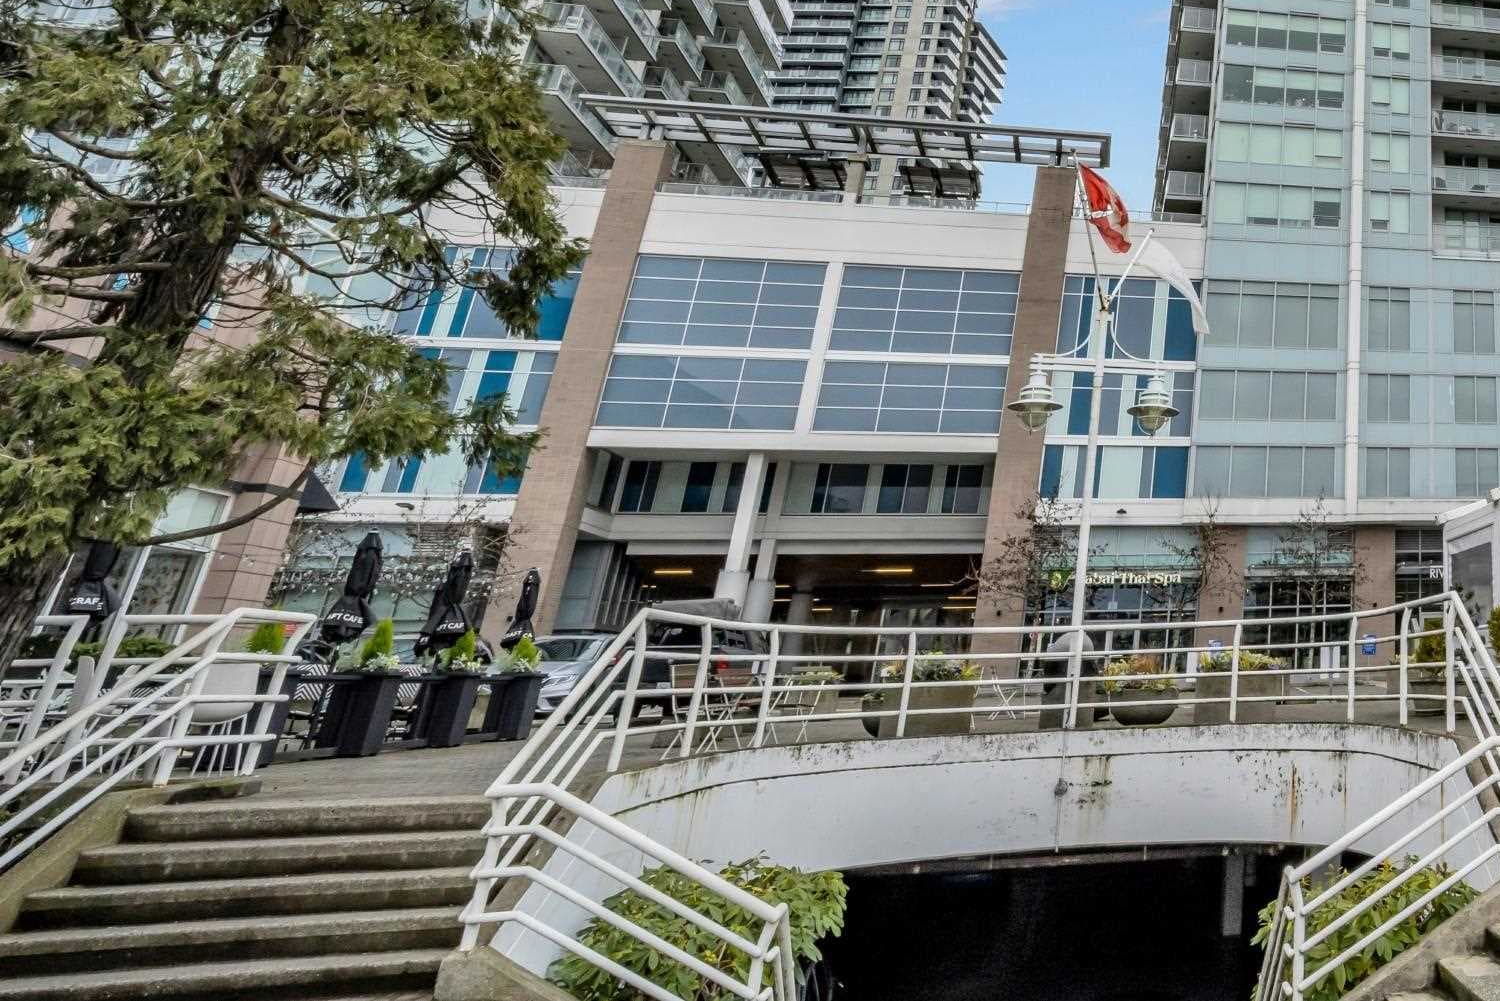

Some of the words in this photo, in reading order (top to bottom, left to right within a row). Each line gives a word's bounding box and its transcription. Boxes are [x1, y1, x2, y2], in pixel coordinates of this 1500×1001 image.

[1085, 572, 1115, 585] abai
[1154, 571, 1182, 586] Spa
[343, 613, 364, 624] CAFE
